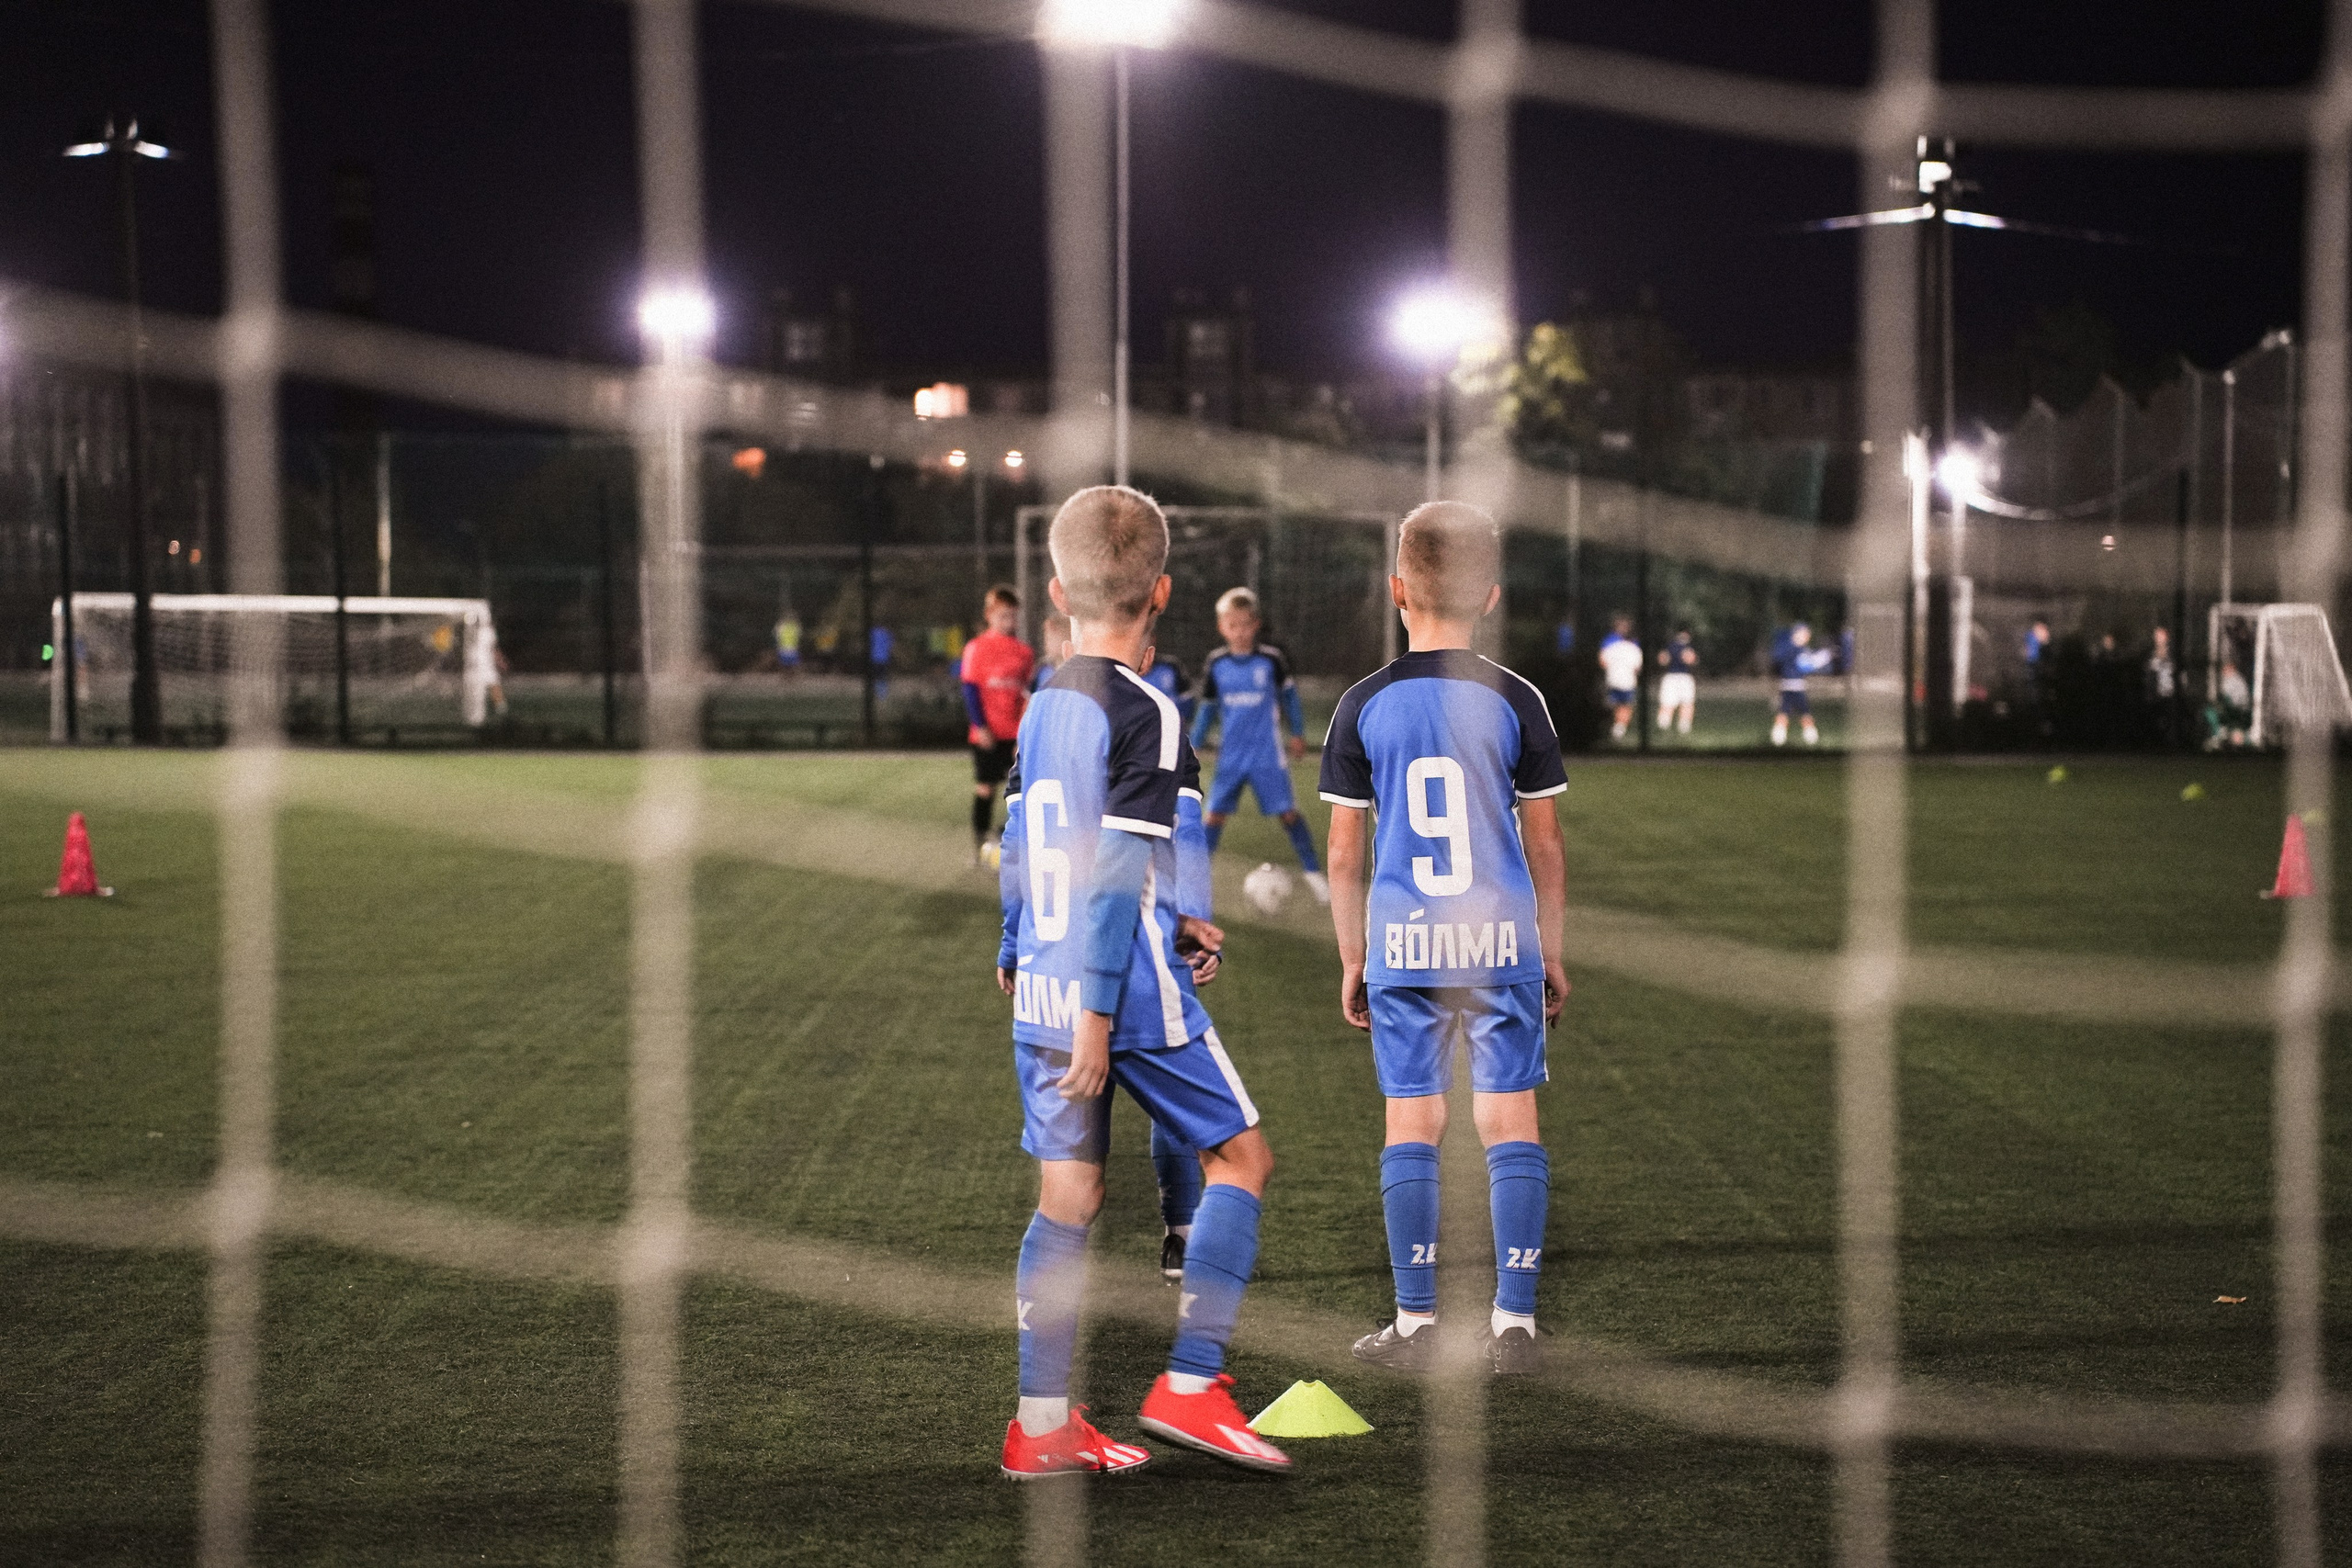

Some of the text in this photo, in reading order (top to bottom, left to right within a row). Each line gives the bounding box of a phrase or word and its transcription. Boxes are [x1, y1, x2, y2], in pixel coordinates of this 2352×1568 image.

[1025, 779, 1071, 942] 6
[1407, 756, 1473, 897] 9
[1505, 1247, 1542, 1269] 2K
